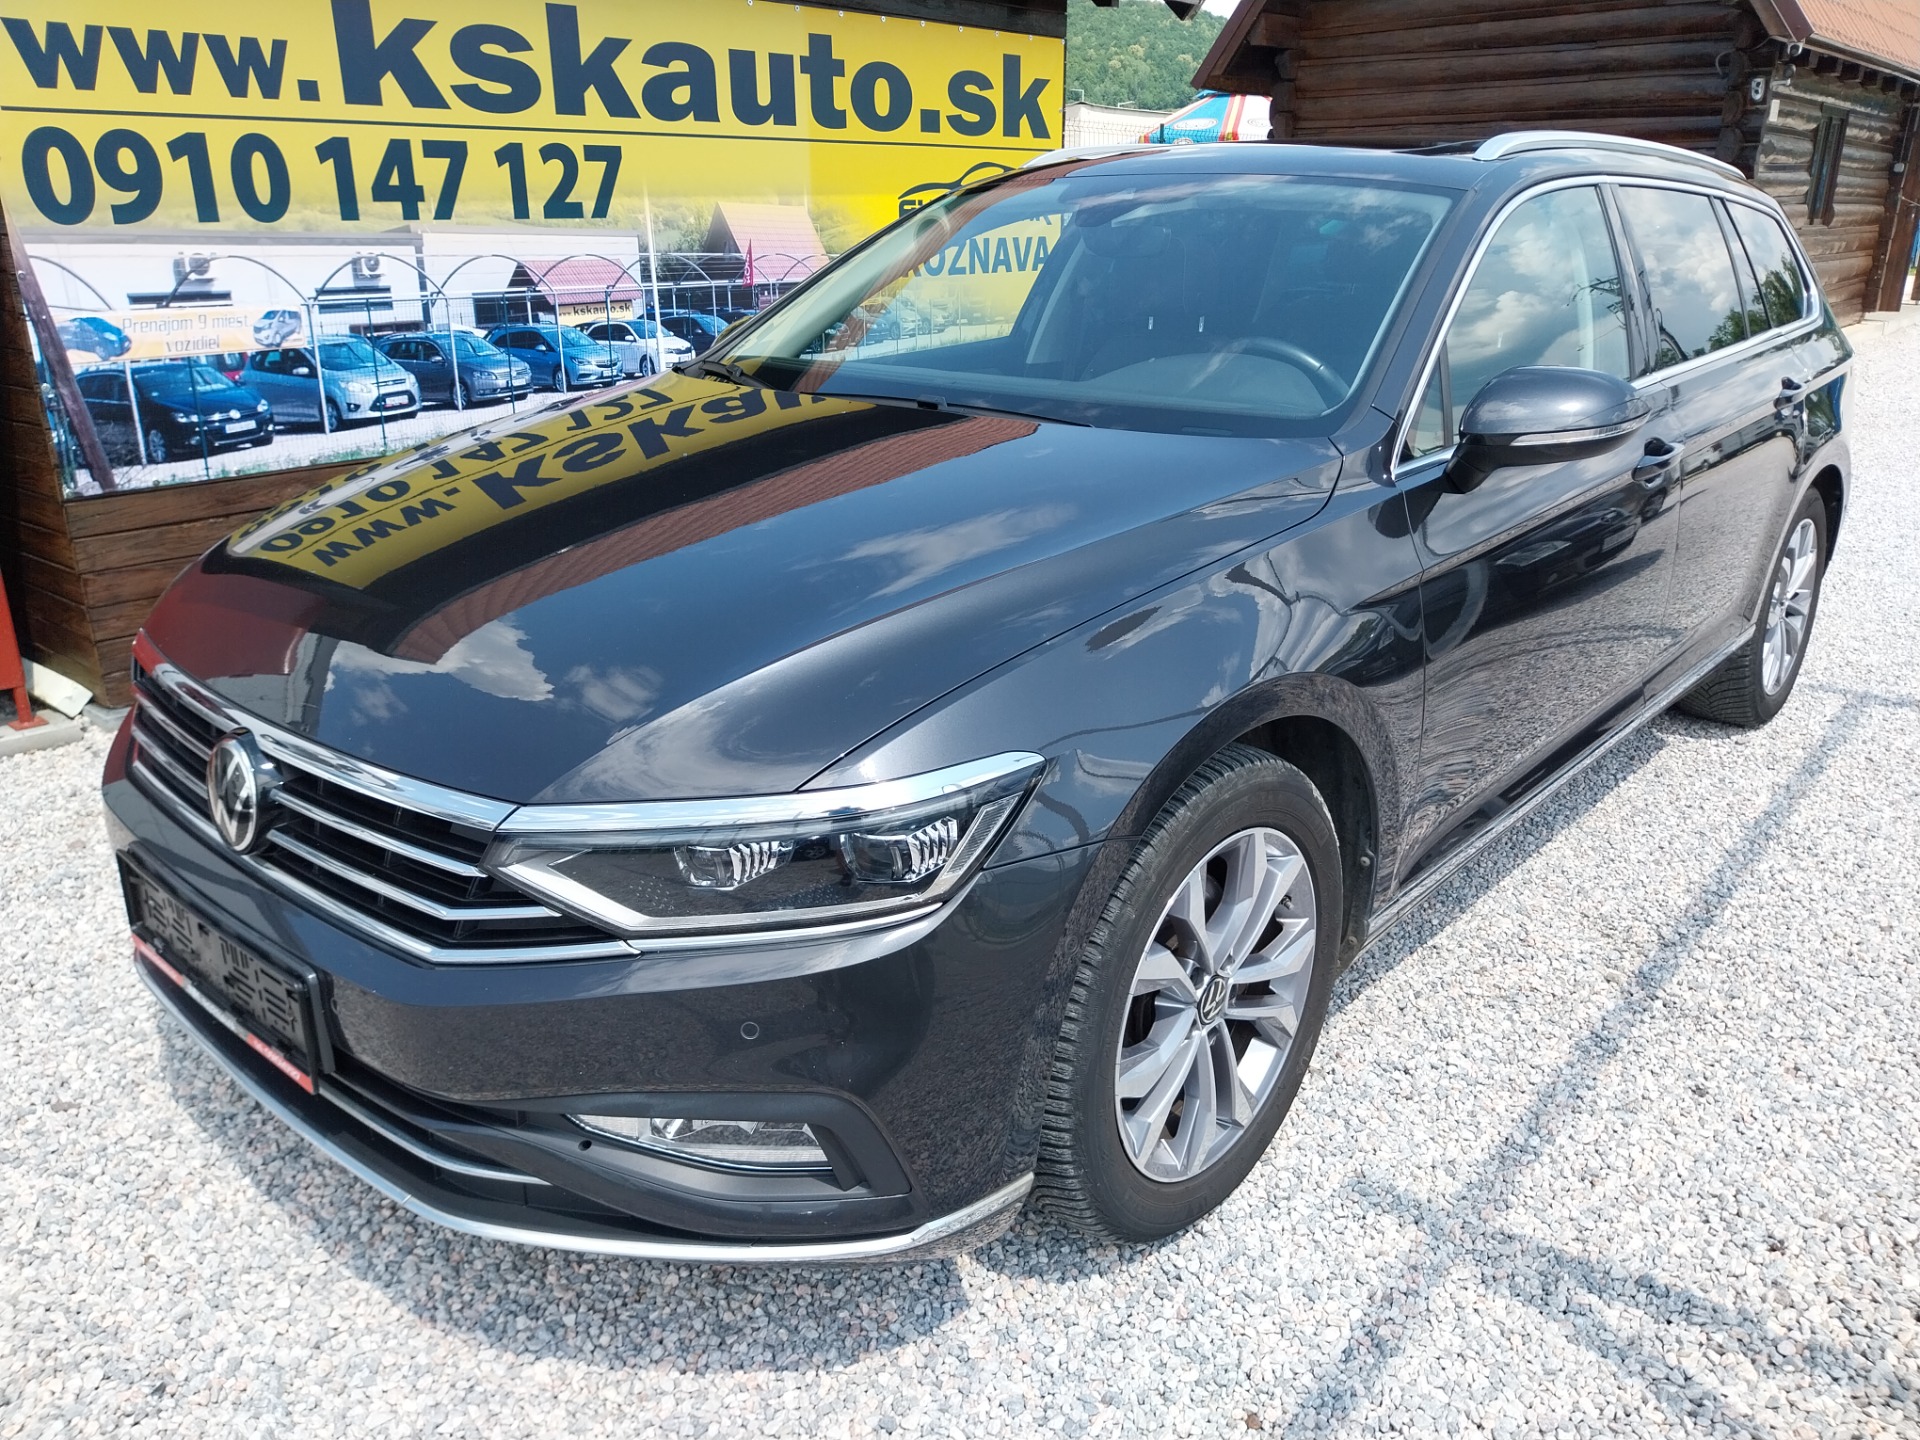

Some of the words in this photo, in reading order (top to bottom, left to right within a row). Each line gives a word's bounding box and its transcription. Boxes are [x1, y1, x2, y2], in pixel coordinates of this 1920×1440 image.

[0, 0, 1052, 140] www.kskauto.sk
[21, 126, 291, 225] 0910
[315, 137, 468, 221] 147
[494, 143, 622, 219] 127
[198, 314, 207, 329] 9
